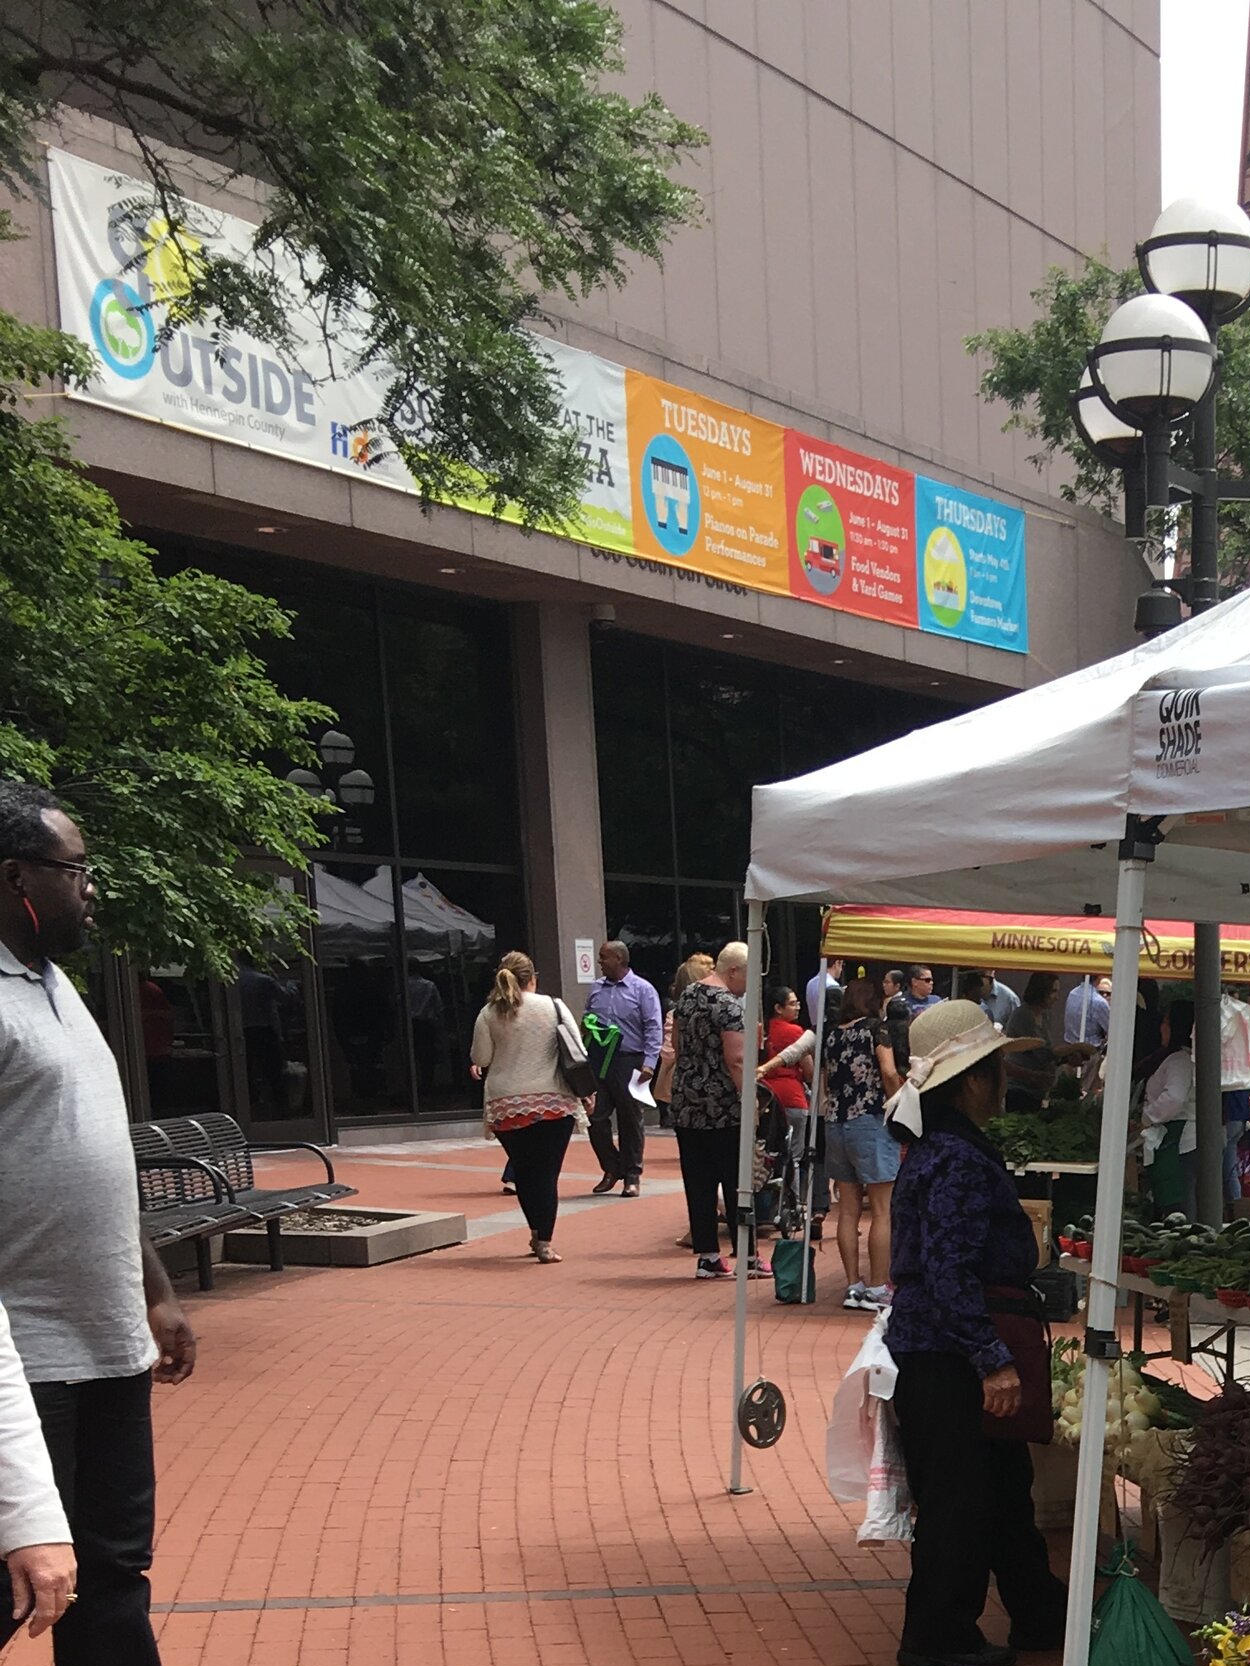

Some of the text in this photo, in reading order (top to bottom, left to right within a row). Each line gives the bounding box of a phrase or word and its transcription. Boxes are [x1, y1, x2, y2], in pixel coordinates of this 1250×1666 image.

[163, 391, 286, 441] with Hennepin County
[563, 408, 616, 443] AT THE
[661, 399, 752, 457] TUESDAYS
[702, 463, 722, 482] June
[734, 474, 763, 495] August
[764, 483, 773, 498] 31
[800, 448, 900, 507] WEDNESDAYS
[704, 512, 779, 549] Pianos on Parade
[849, 511, 865, 527] June
[876, 519, 900, 539] August
[935, 495, 1007, 542] THURSDAYS
[705, 536, 767, 568] Performances
[851, 555, 901, 584] Food Vendors
[852, 577, 903, 605] & Yard Games
[1156, 719, 1202, 762] SHADE
[991, 931, 1092, 955] MINNESOTA
